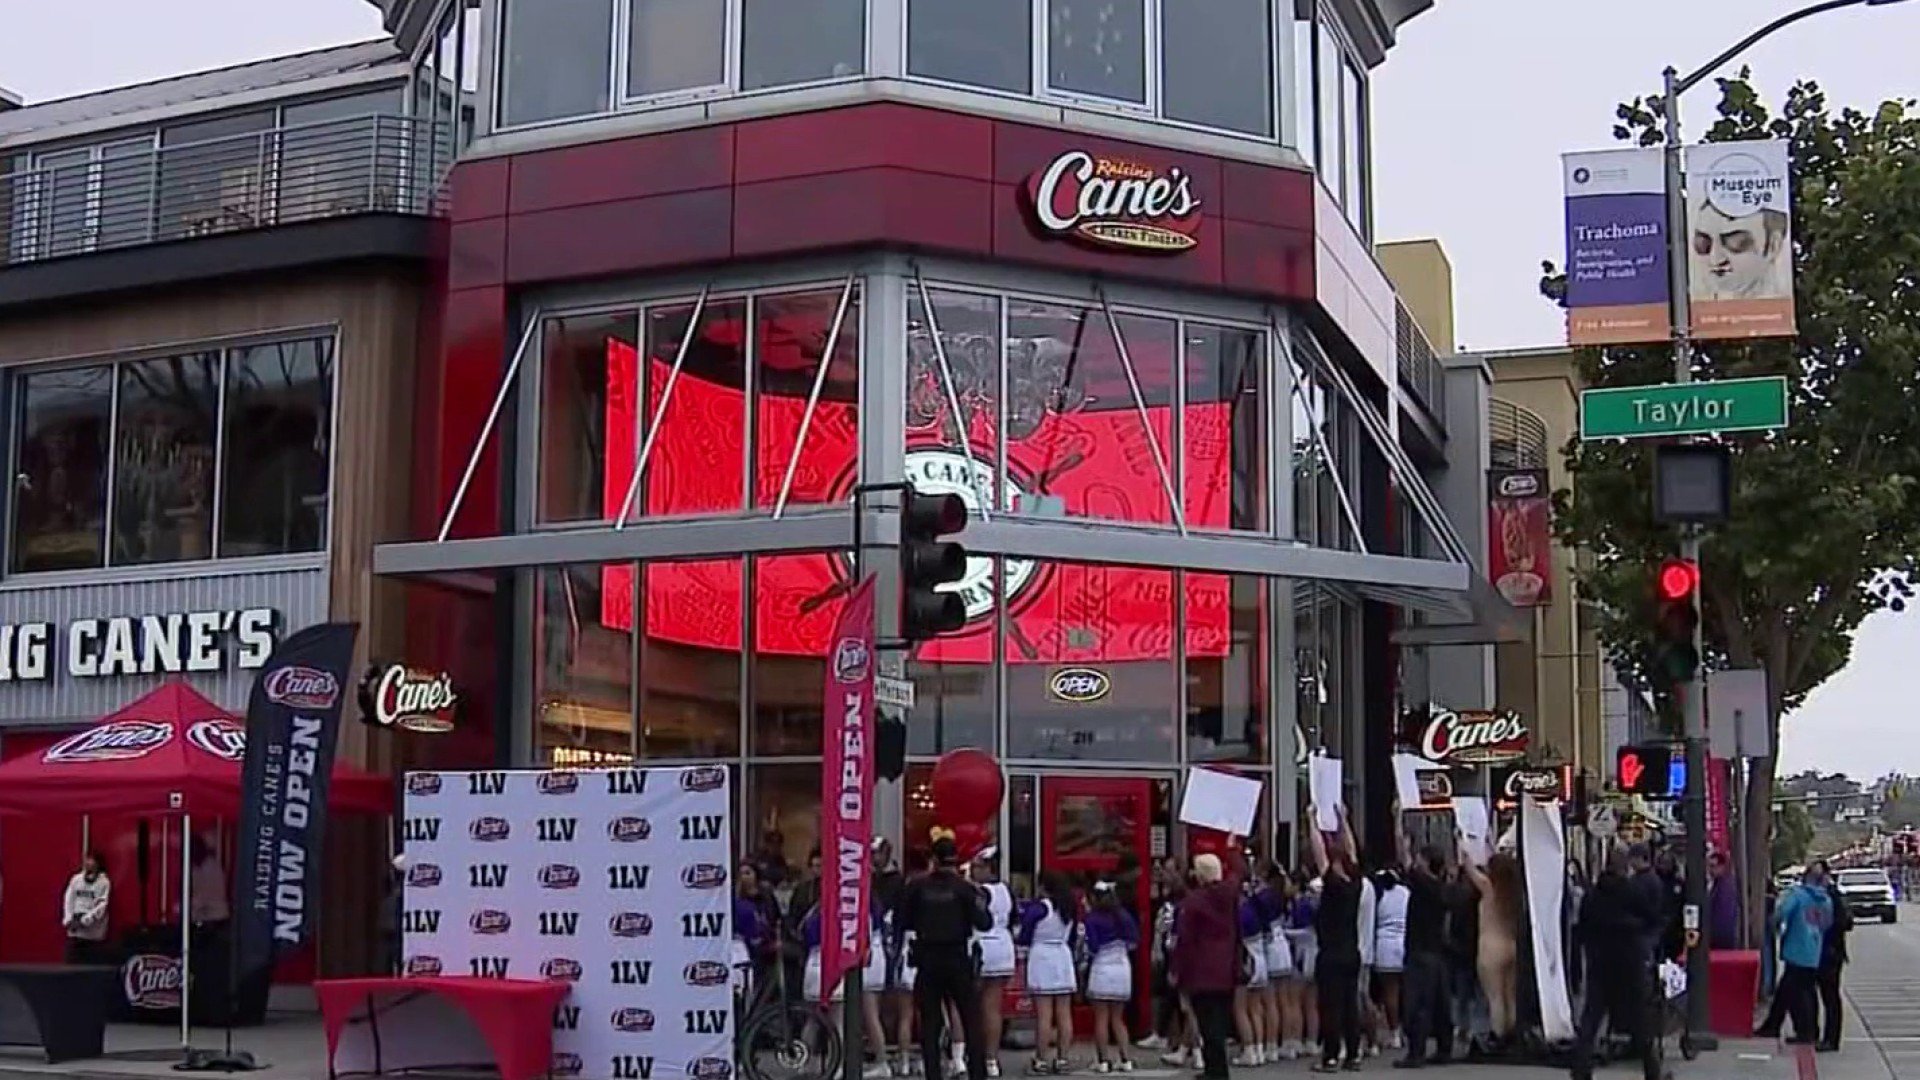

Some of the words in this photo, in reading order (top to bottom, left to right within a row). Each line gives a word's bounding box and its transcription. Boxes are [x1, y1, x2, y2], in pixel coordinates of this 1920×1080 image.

[1037, 151, 1202, 230] Cane's
[1712, 178, 1781, 192] Museum
[1742, 191, 1773, 206] Eye
[1573, 222, 1659, 241] Trachoma
[1633, 397, 1735, 426] Taylor
[69, 609, 273, 678] CANE'S
[377, 665, 457, 724] Cane's
[1055, 676, 1100, 693] OPEN
[1423, 711, 1531, 760] Cane's
[839, 692, 864, 821] OPEN
[261, 744, 284, 816] CANE'S
[283, 716, 322, 828] OPEN
[607, 771, 648, 794] 1LV
[469, 773, 507, 795] 1LV
[405, 818, 441, 841] 1LV
[537, 818, 577, 841] 1LV
[680, 816, 723, 840] 1LV
[470, 865, 509, 887] 1LV
[608, 866, 650, 889] 1LV
[274, 839, 306, 943] NOW
[404, 910, 441, 933] 1LV
[539, 912, 579, 935] 1LV
[682, 913, 725, 937] 1LV
[470, 957, 510, 979] 1LV
[610, 961, 652, 984] 1LV
[553, 1006, 581, 1030] LV
[684, 1010, 727, 1034] 1LV
[612, 1056, 654, 1080] 1LV
